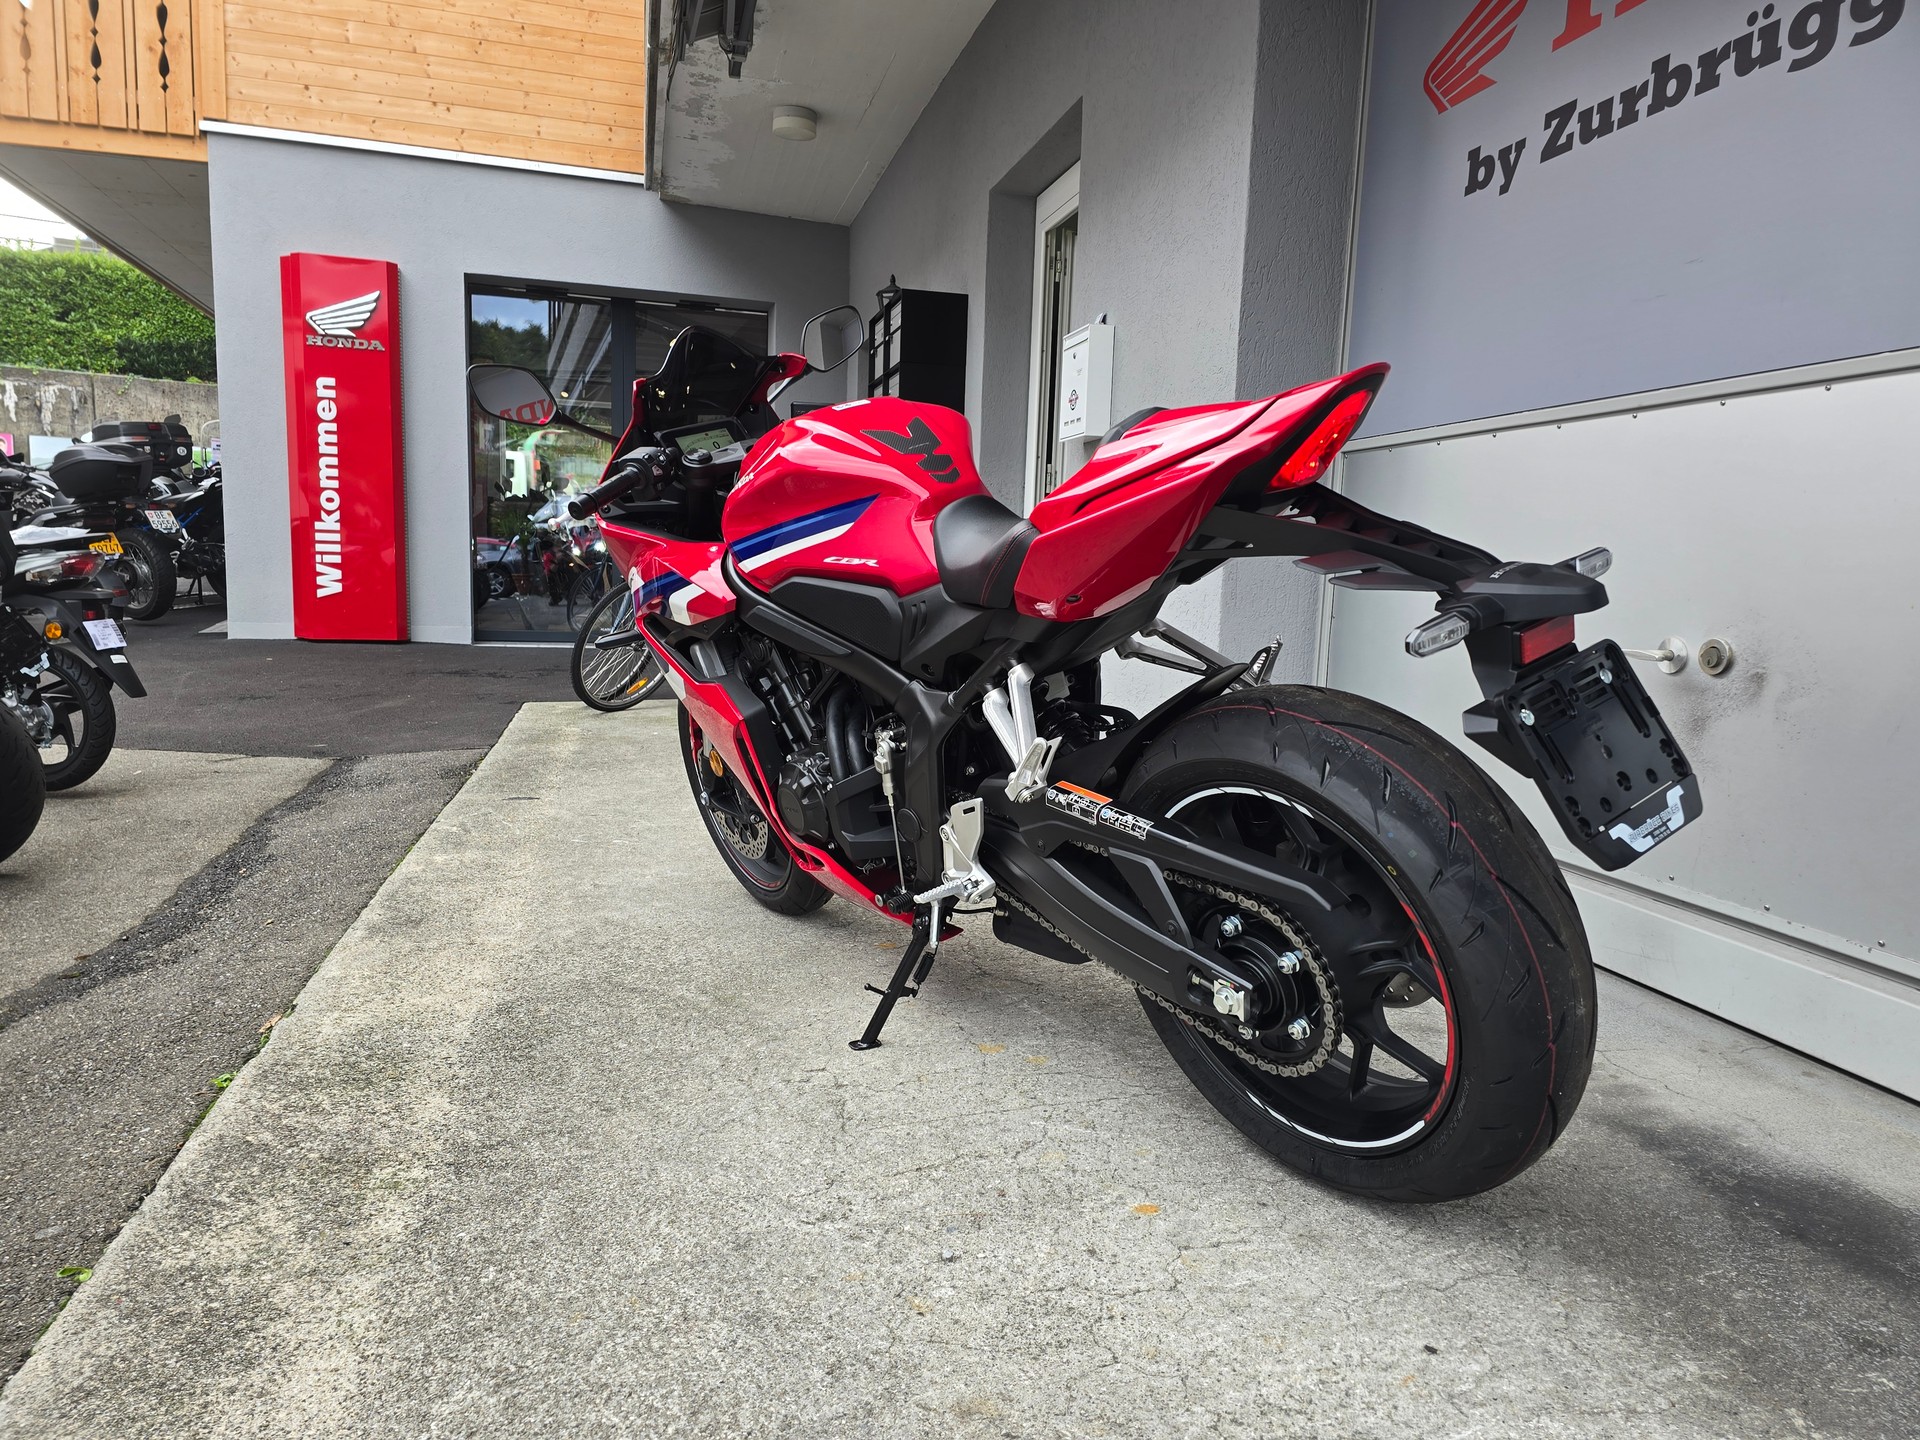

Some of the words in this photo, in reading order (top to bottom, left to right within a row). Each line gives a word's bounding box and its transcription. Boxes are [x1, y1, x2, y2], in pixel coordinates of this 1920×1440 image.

[1464, 137, 1527, 197] by
[1540, 0, 1906, 164] Zurbrügg
[306, 335, 386, 351] HONDA
[314, 376, 343, 598] Willkommen
[823, 556, 880, 567] CBR
